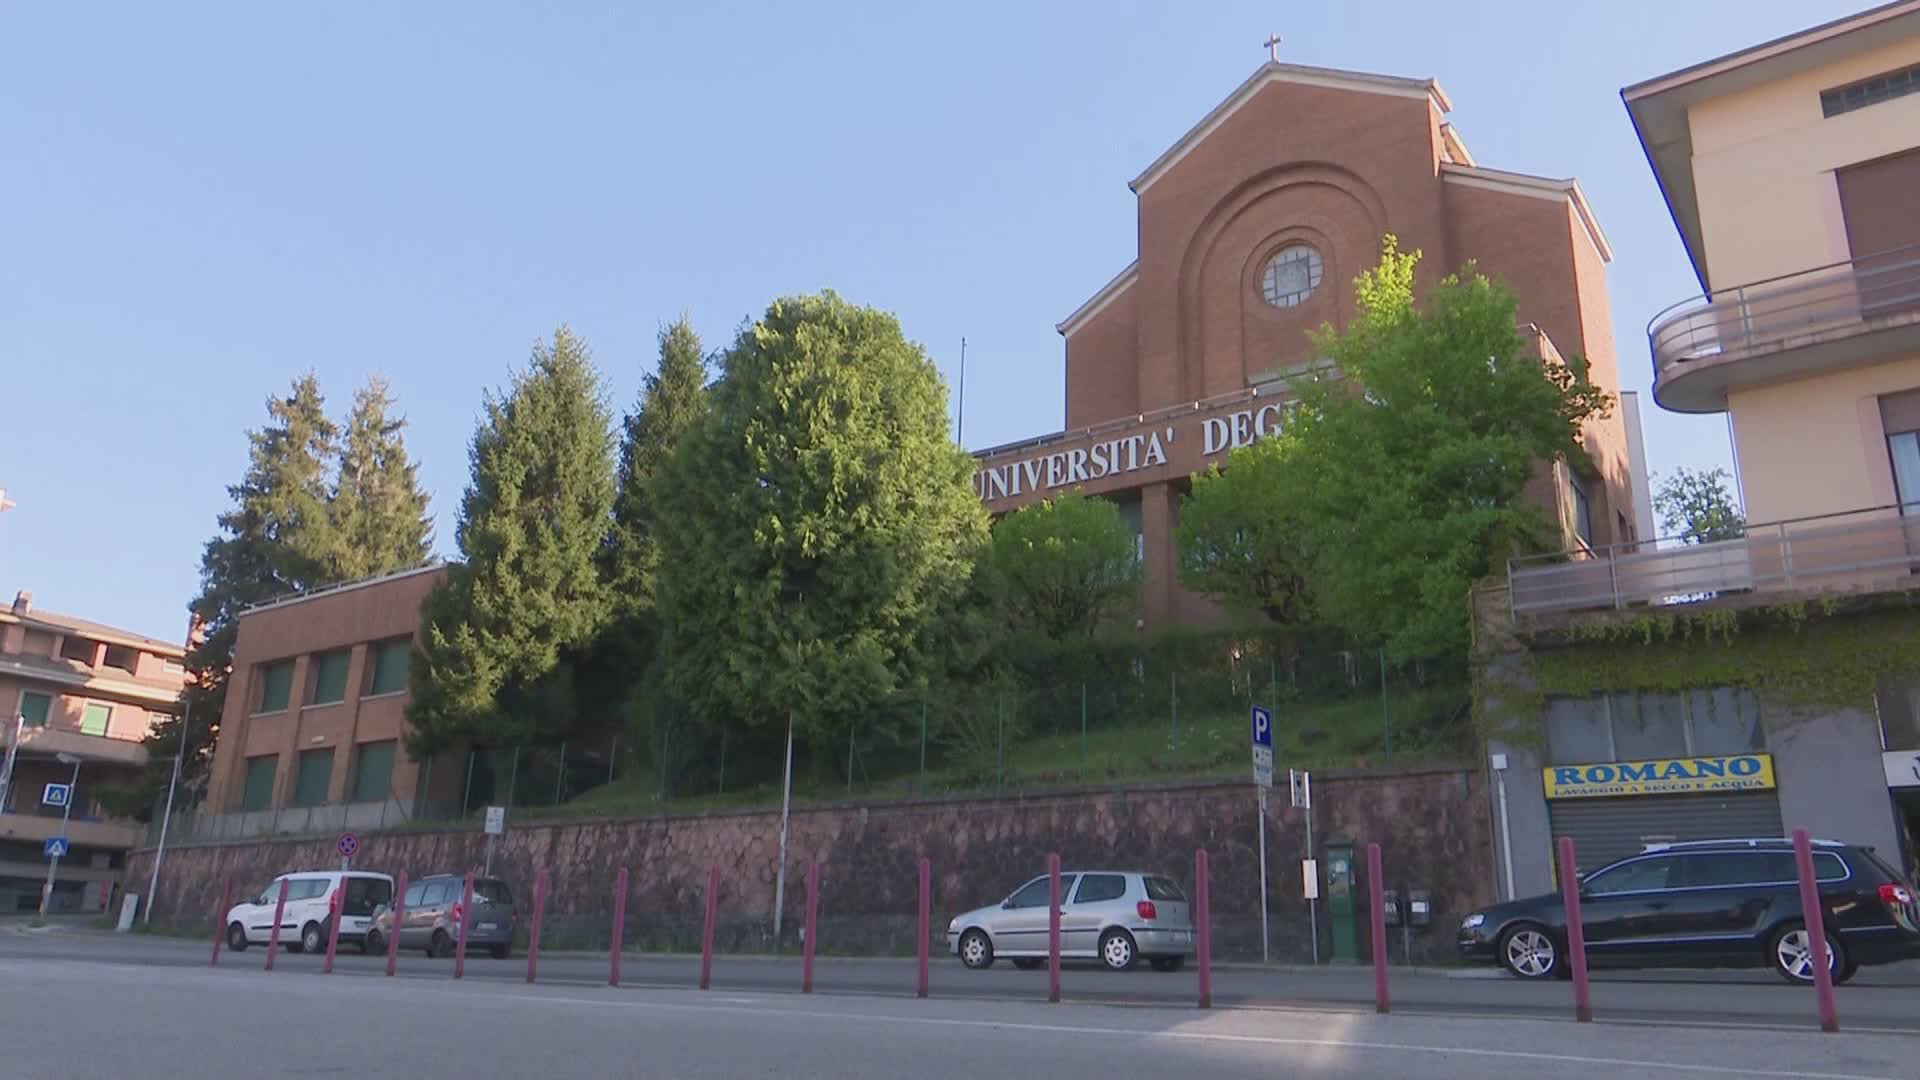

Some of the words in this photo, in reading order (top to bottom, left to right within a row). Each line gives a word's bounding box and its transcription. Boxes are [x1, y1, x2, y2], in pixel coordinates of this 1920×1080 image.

[1255, 710, 1268, 741] P
[1553, 757, 1762, 784] ROMANO
[1554, 785, 1624, 796] LAVAGGIO
[1644, 783, 1691, 792] SECCO
[1711, 779, 1764, 790] ACQUA
